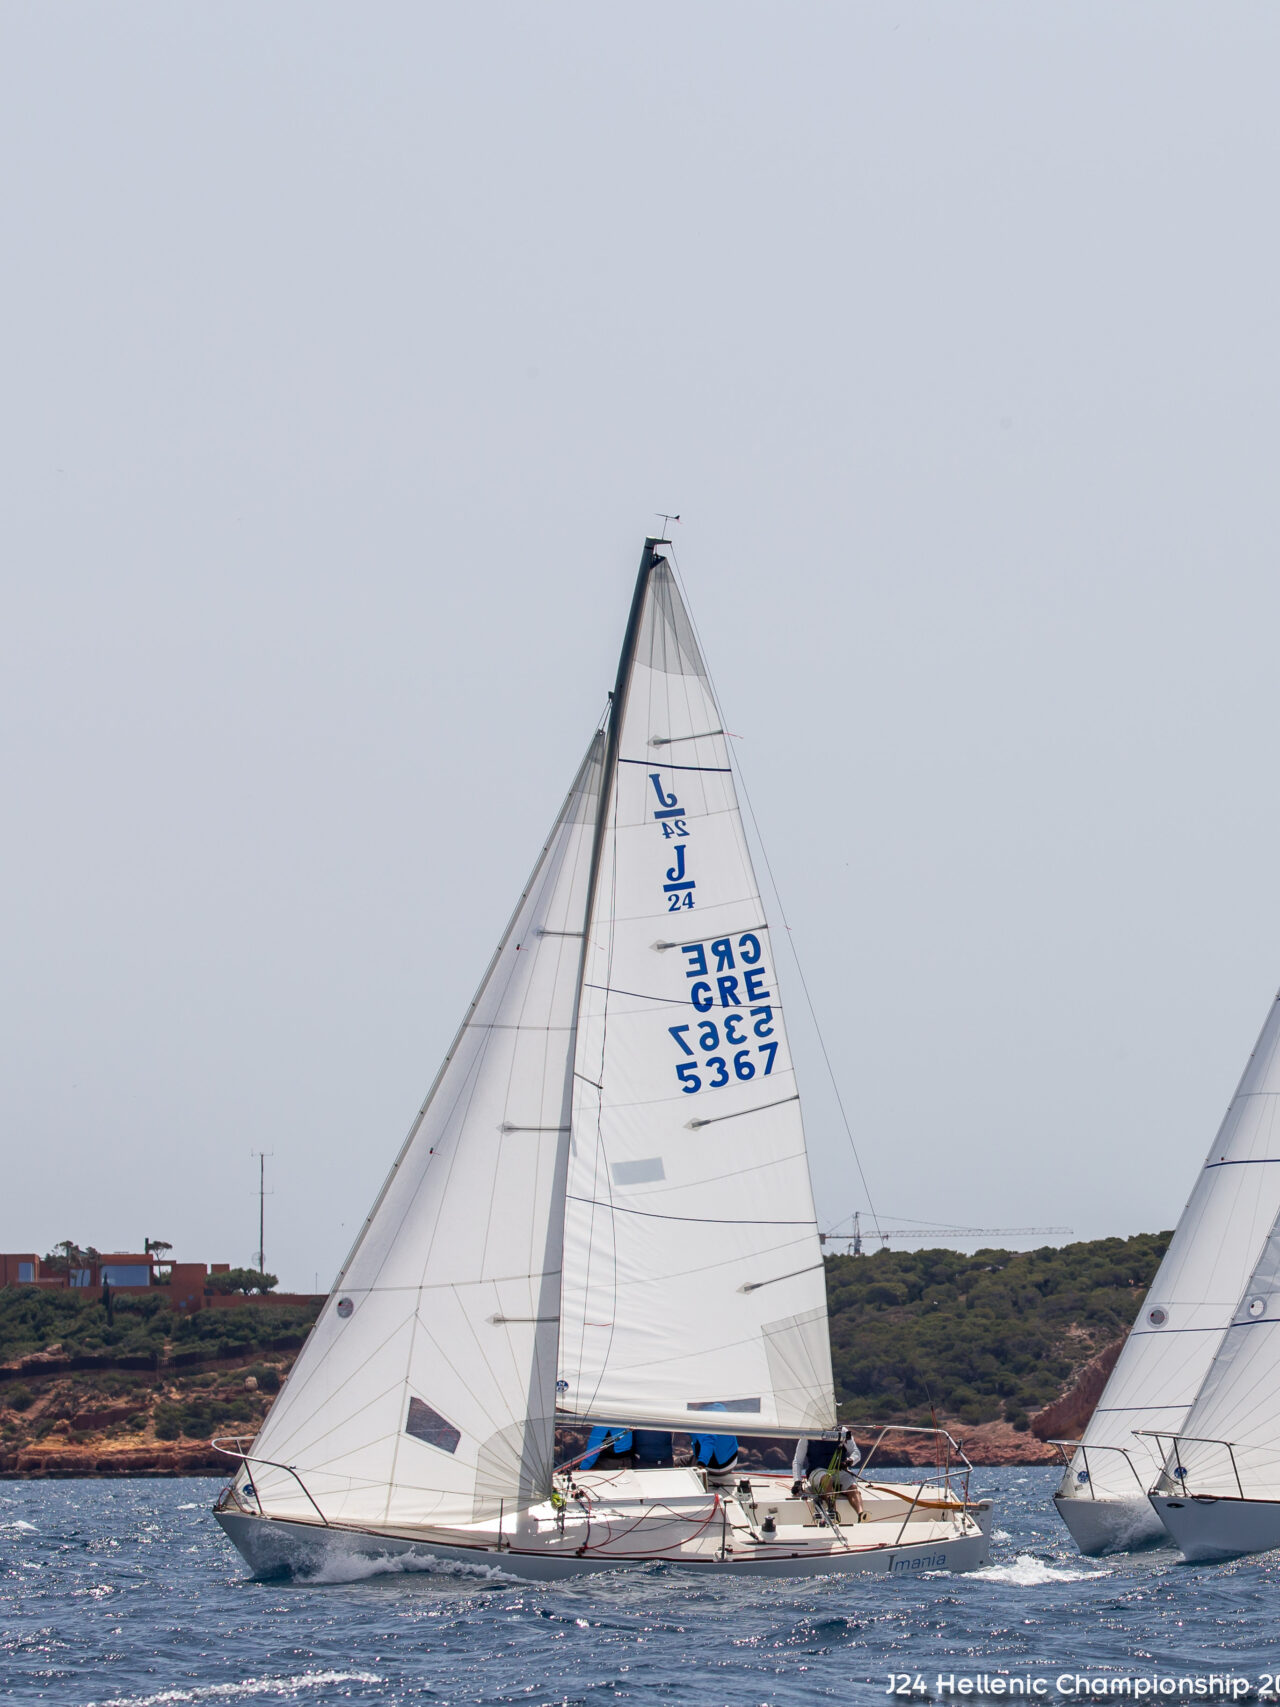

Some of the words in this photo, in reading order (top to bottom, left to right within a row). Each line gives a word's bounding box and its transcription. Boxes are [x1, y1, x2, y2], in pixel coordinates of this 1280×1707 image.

[666, 845, 686, 882] J
[668, 891, 696, 912] 24
[691, 967, 770, 1013] GRE
[676, 1041, 779, 1094] 5367
